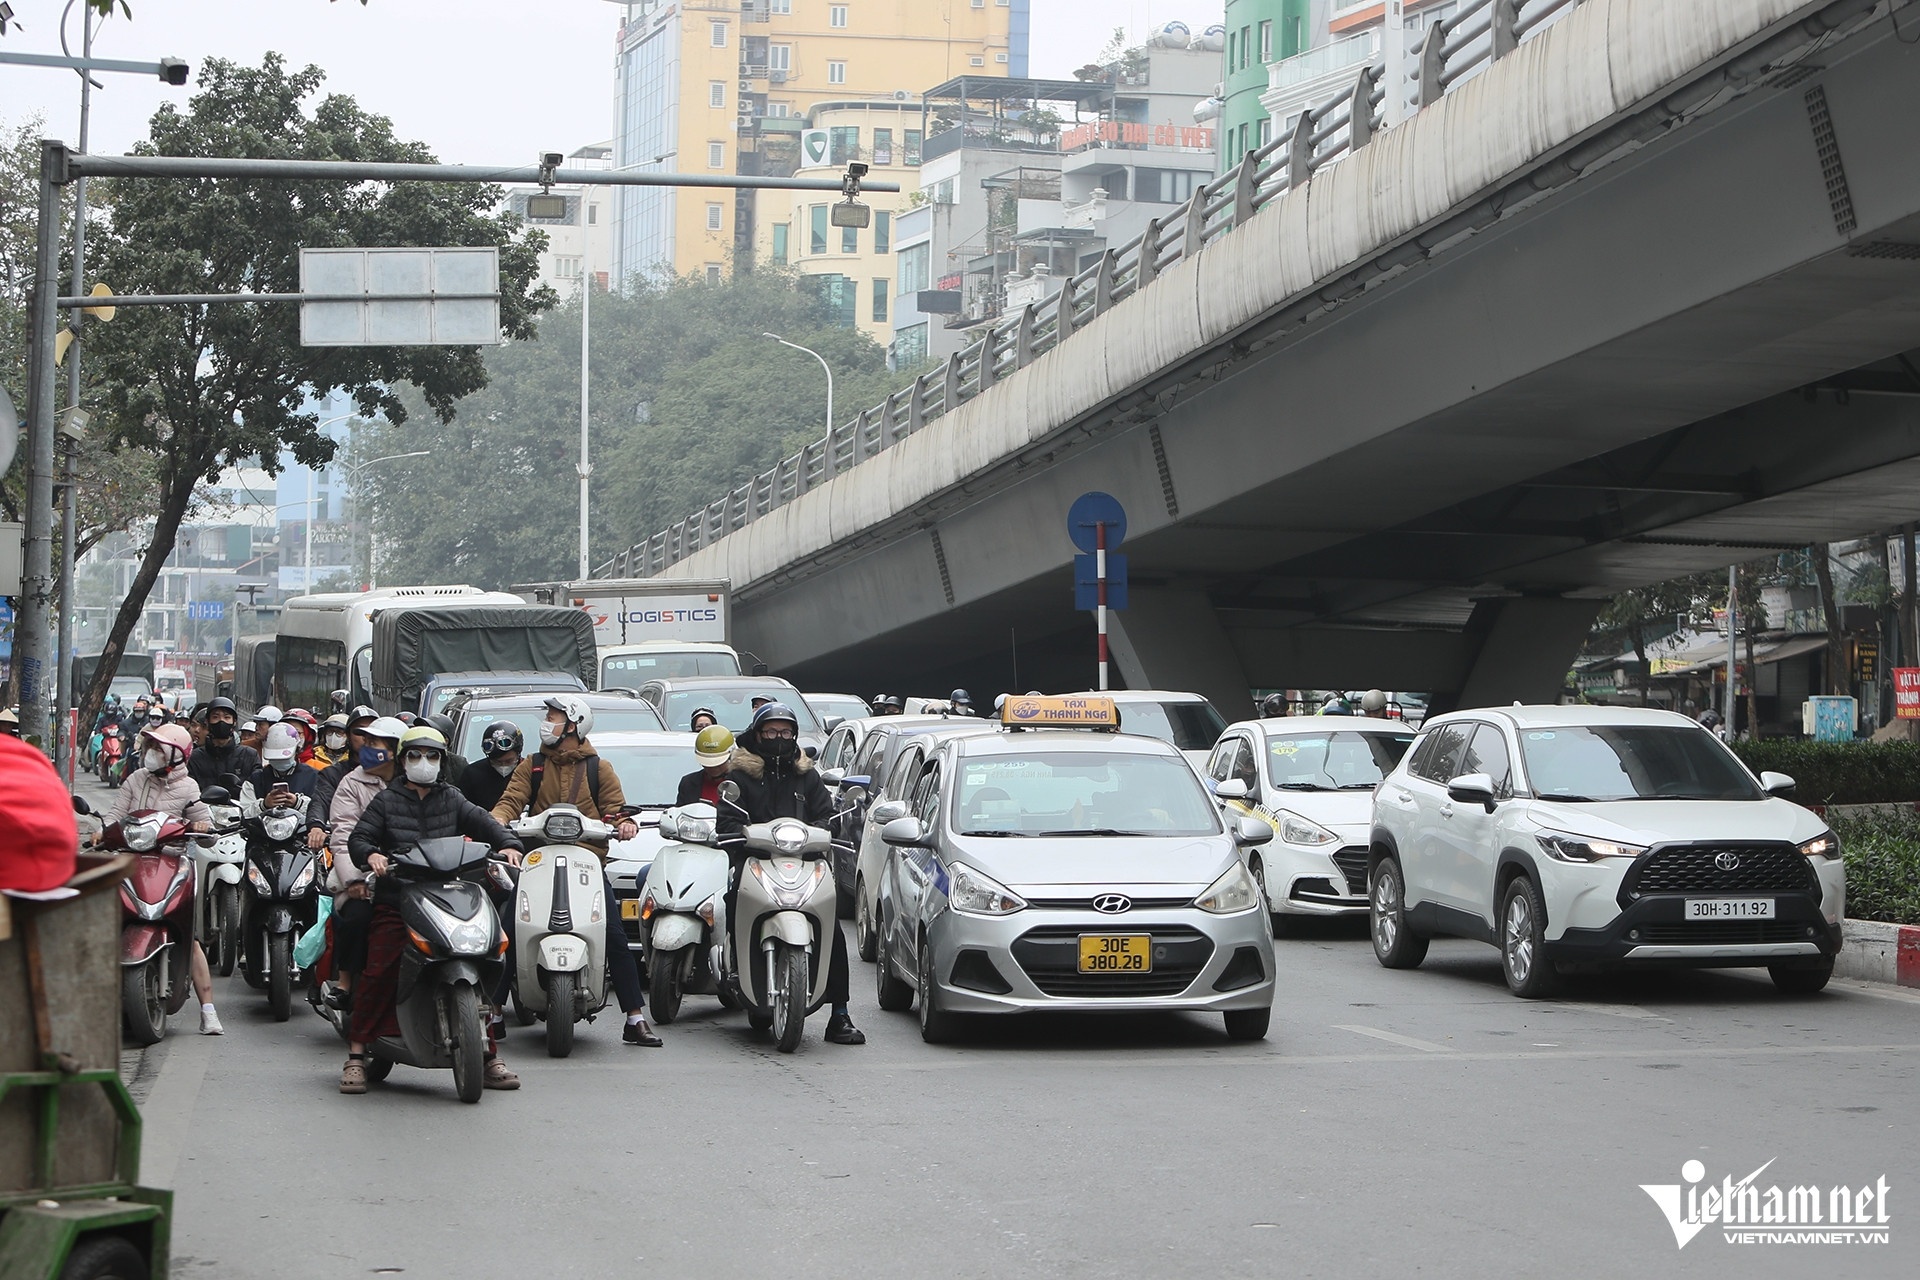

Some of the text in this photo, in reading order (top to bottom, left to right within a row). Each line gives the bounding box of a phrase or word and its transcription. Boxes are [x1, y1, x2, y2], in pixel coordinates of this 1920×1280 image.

[617, 609, 717, 623] LOGISTICS
[1063, 700, 1087, 708] TAXI
[1043, 710, 1107, 719] THANH NGA
[1100, 938, 1130, 953] 30E
[1088, 955, 1142, 969] 380.28
